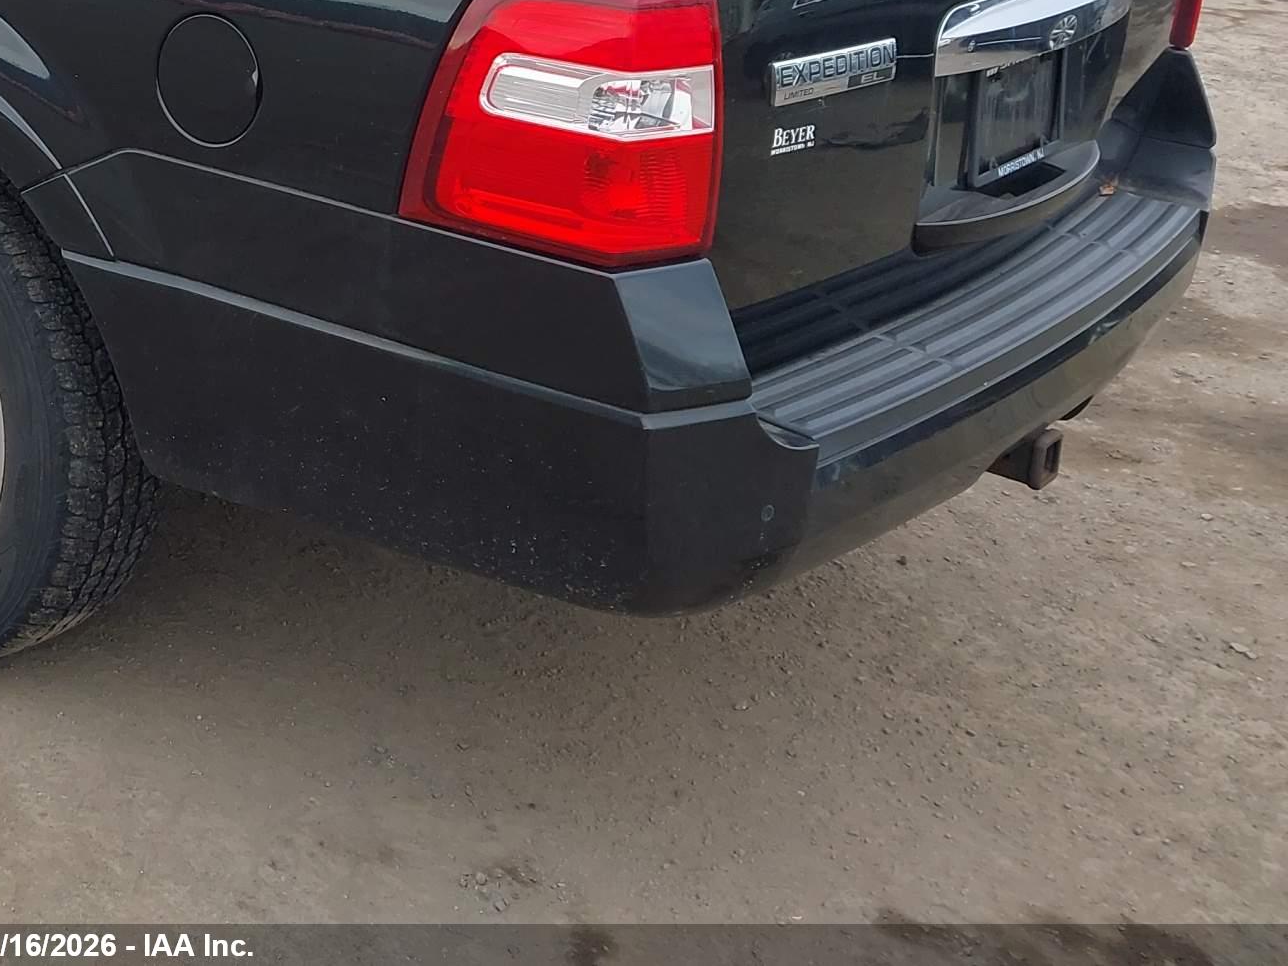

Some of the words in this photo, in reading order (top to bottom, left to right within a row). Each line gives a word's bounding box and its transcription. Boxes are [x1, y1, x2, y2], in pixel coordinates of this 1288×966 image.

[780, 43, 895, 87] EXPEDITION
[860, 71, 885, 84] EL
[783, 87, 814, 101] LIMITED
